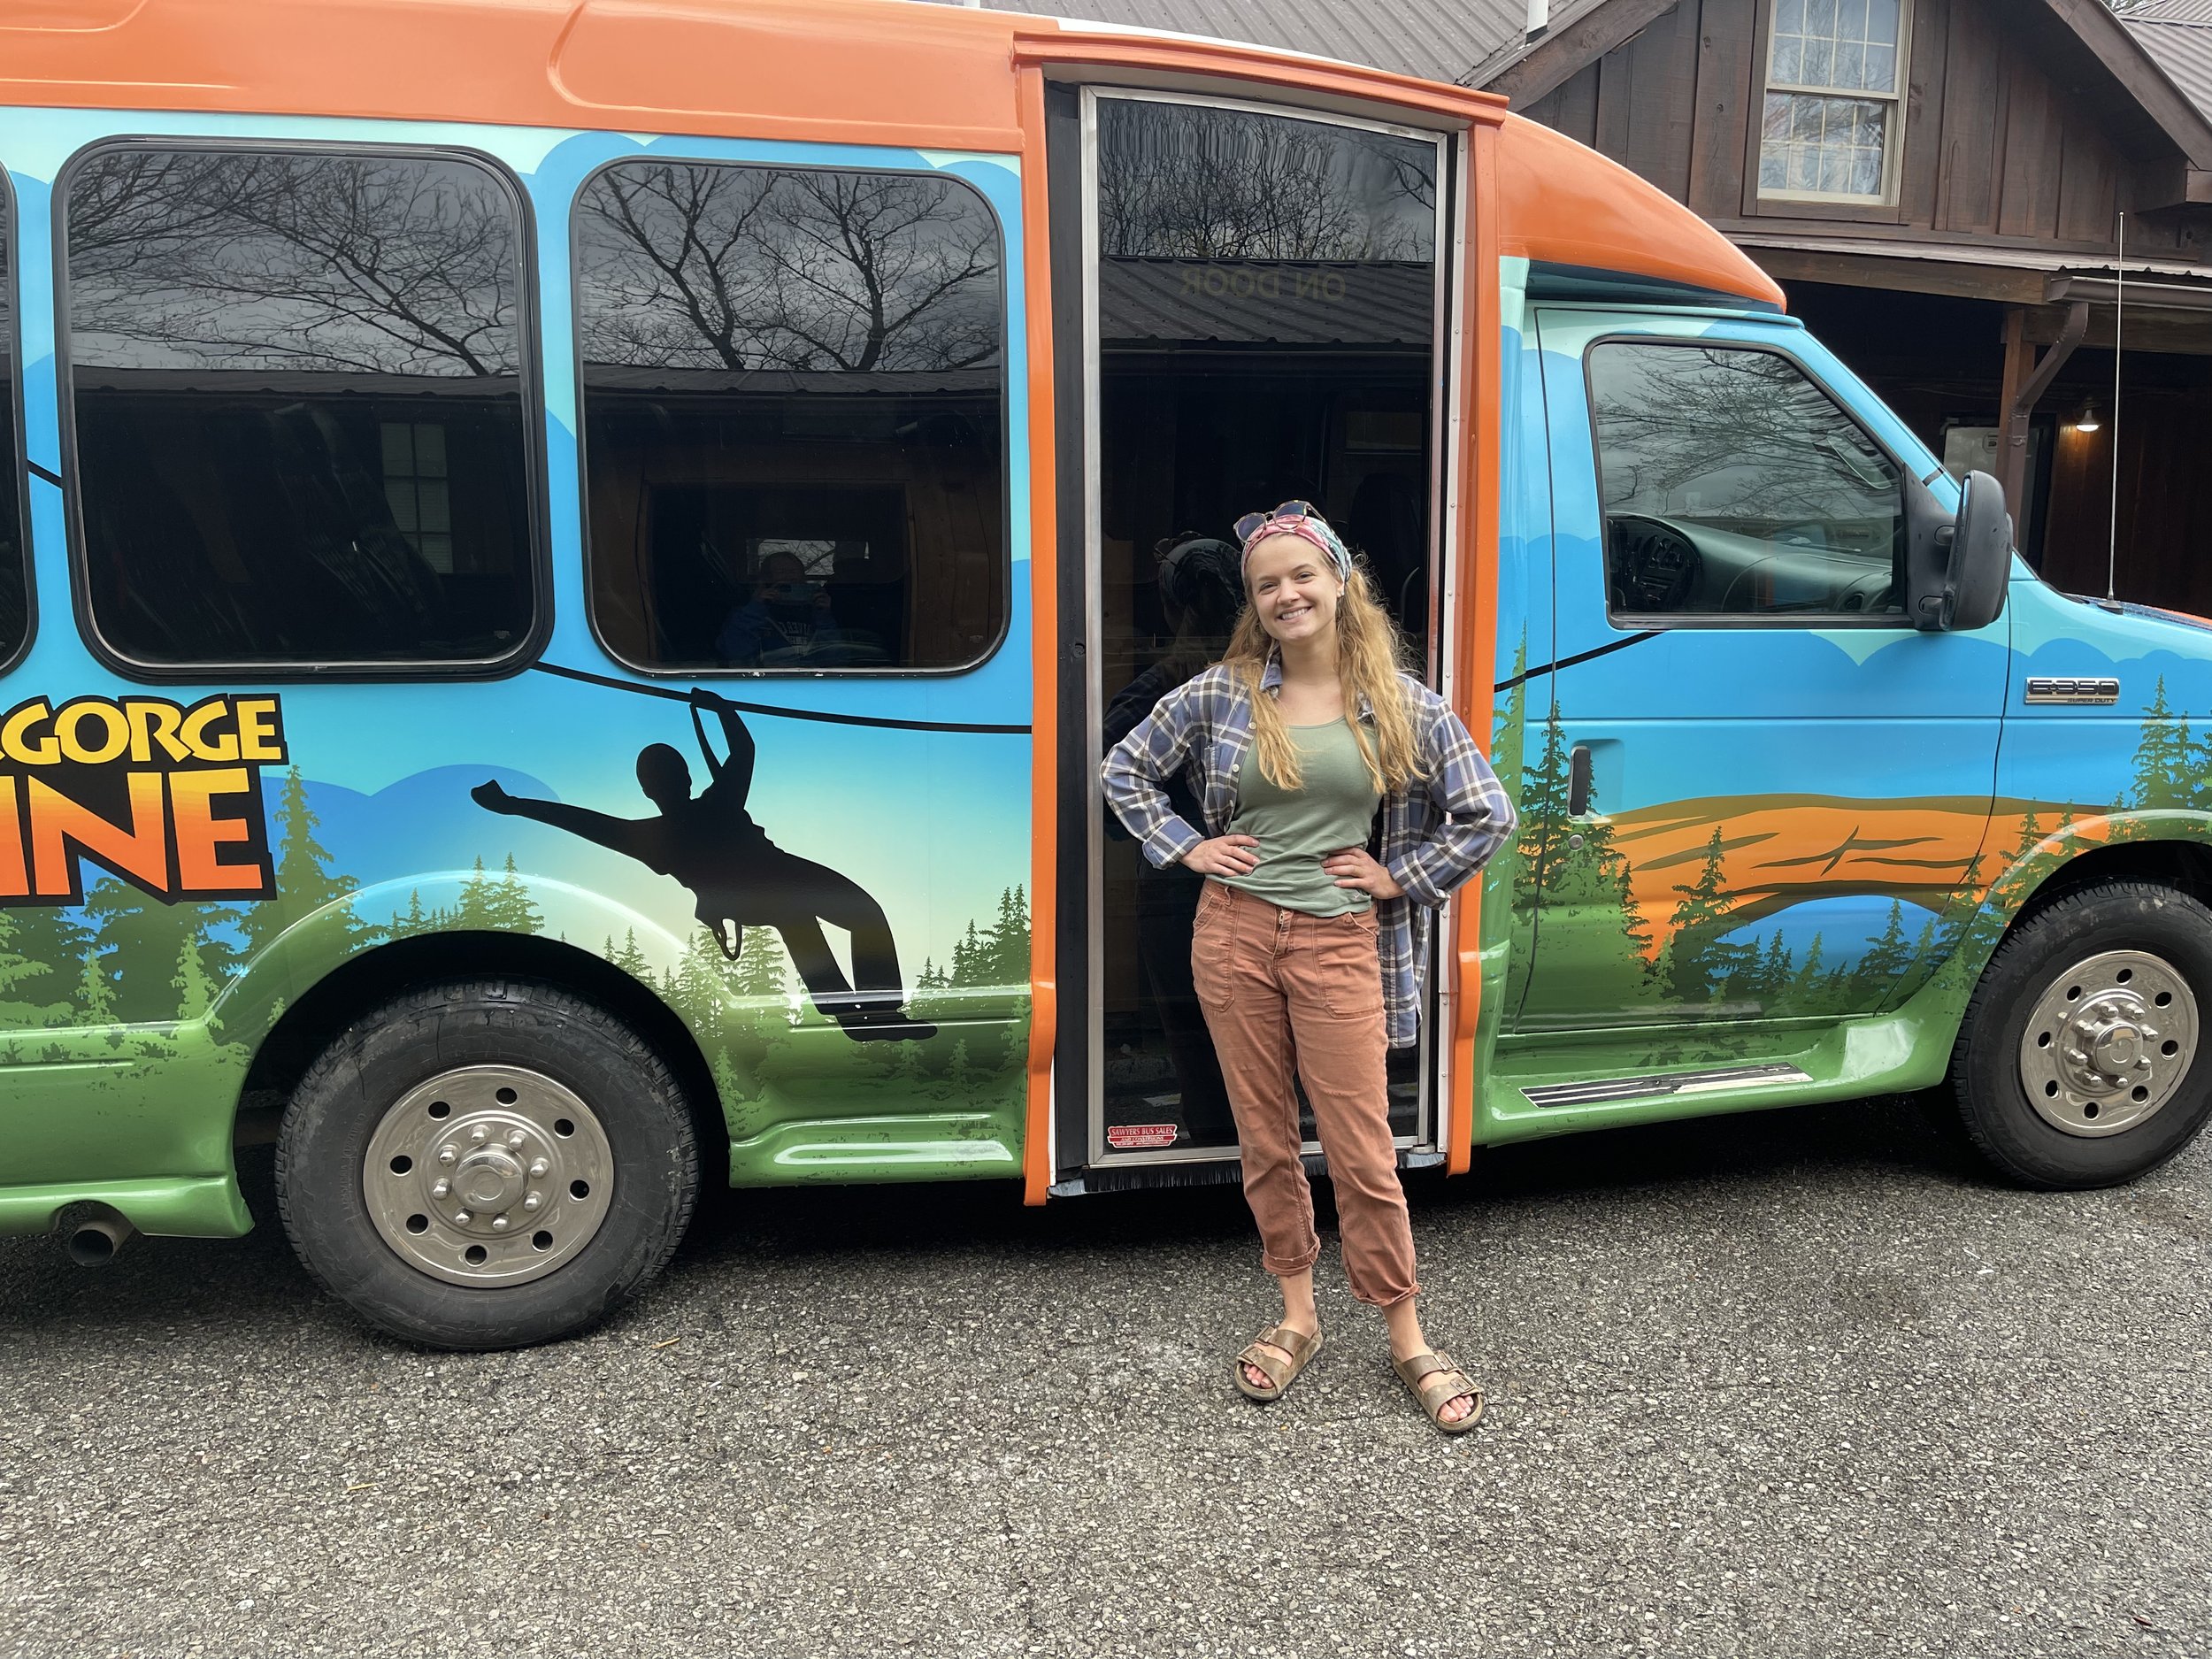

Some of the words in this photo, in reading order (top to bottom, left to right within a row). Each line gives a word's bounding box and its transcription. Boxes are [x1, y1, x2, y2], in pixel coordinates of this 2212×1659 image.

[0, 698, 282, 765] GORGE
[1111, 1127, 1141, 1136] SAWYERS
[1141, 1126, 1154, 1135] BUS
